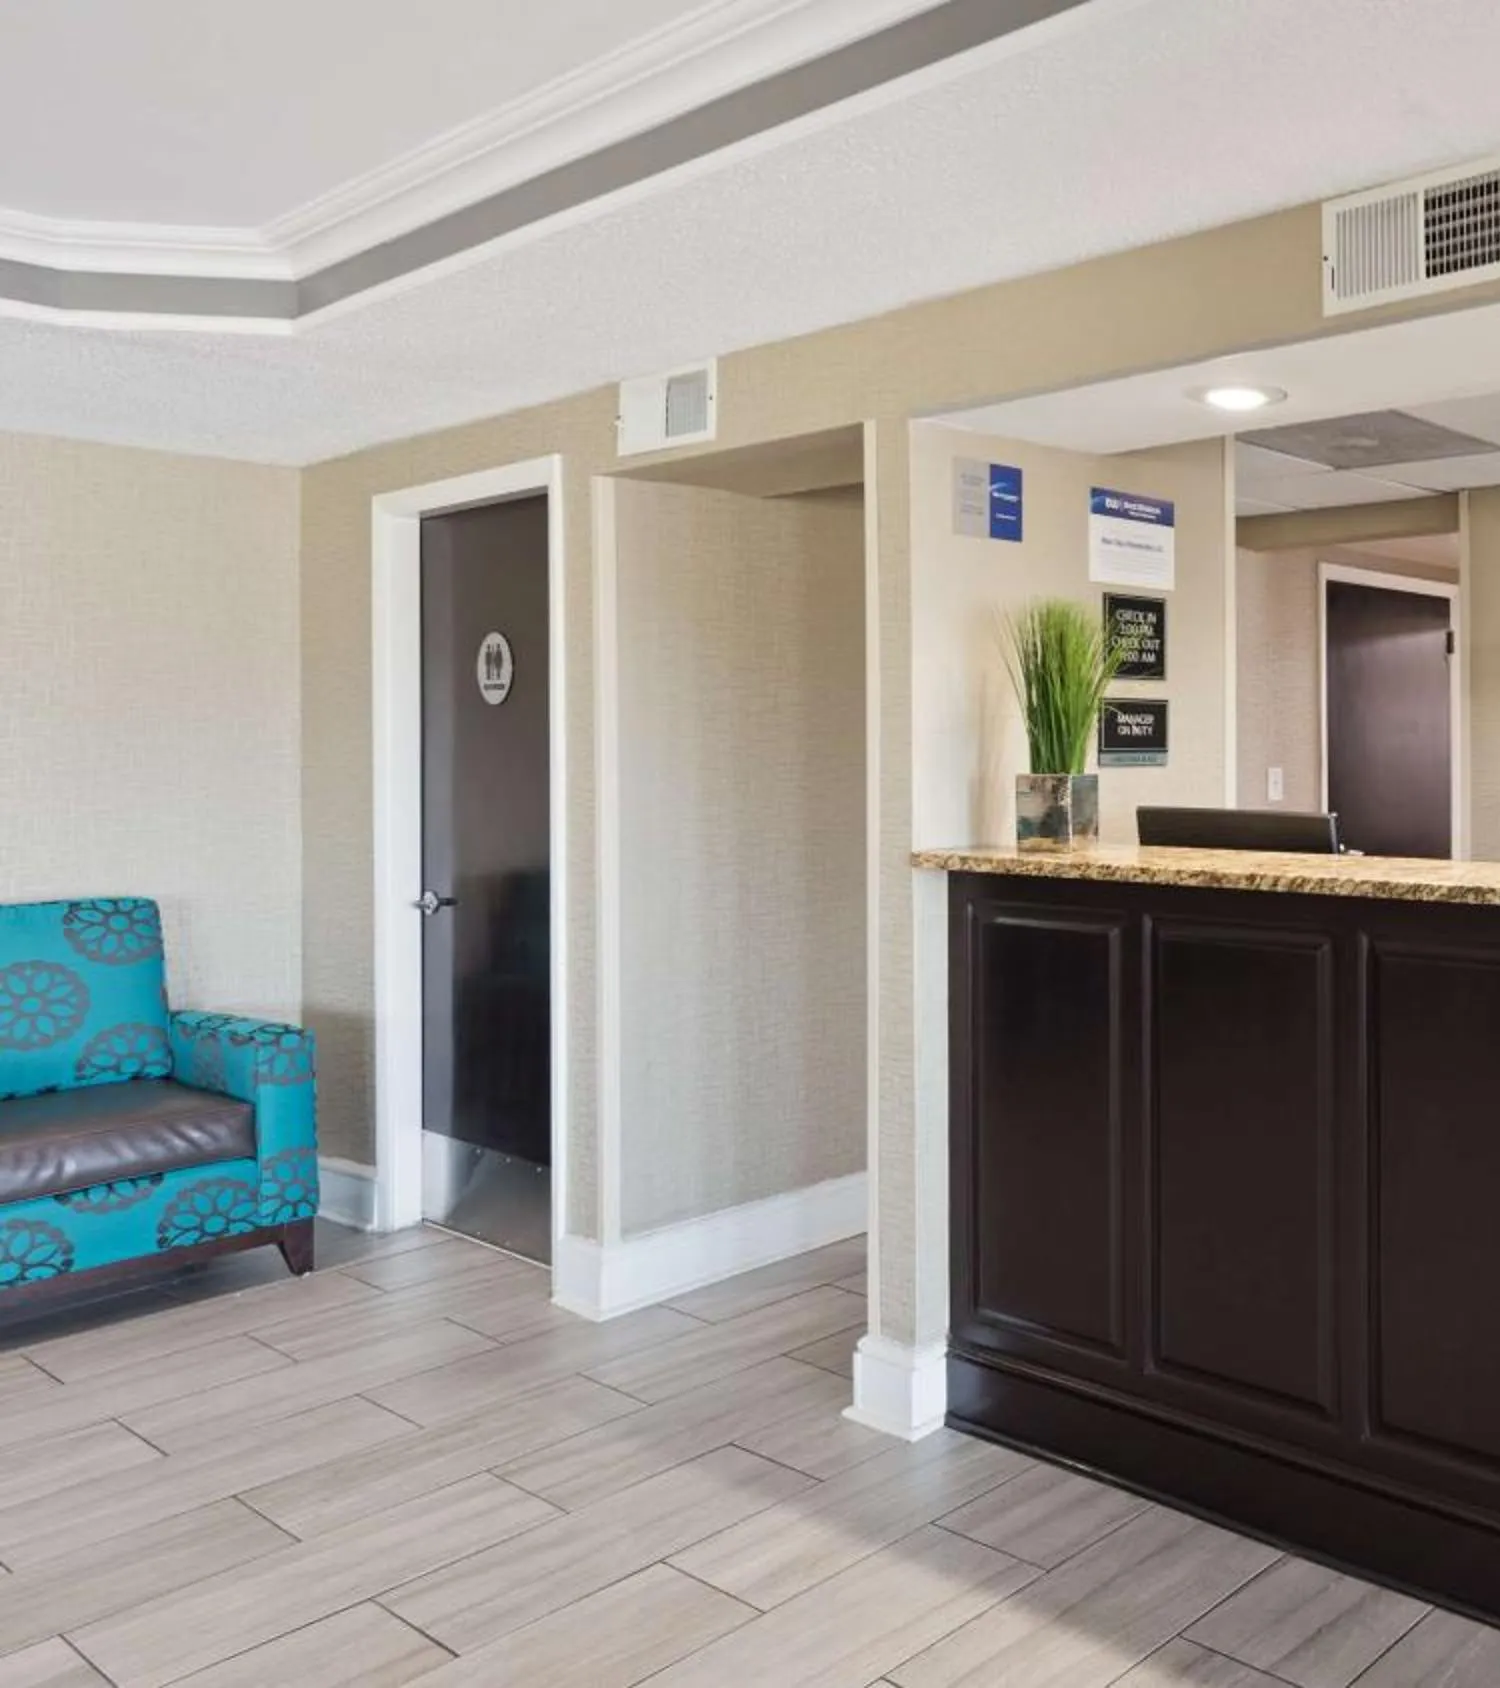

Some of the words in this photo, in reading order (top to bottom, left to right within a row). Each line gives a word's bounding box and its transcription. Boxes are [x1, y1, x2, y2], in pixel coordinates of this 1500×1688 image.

[1115, 609, 1145, 623] CHECK
[1146, 612, 1157, 625] IN
[1112, 635, 1140, 649] CHECK
[1141, 639, 1161, 652] OUT
[1140, 651, 1157, 663] AM
[1117, 712, 1154, 725] MANAGER
[1117, 725, 1131, 736] ON
[1131, 725, 1153, 737] DUTY
